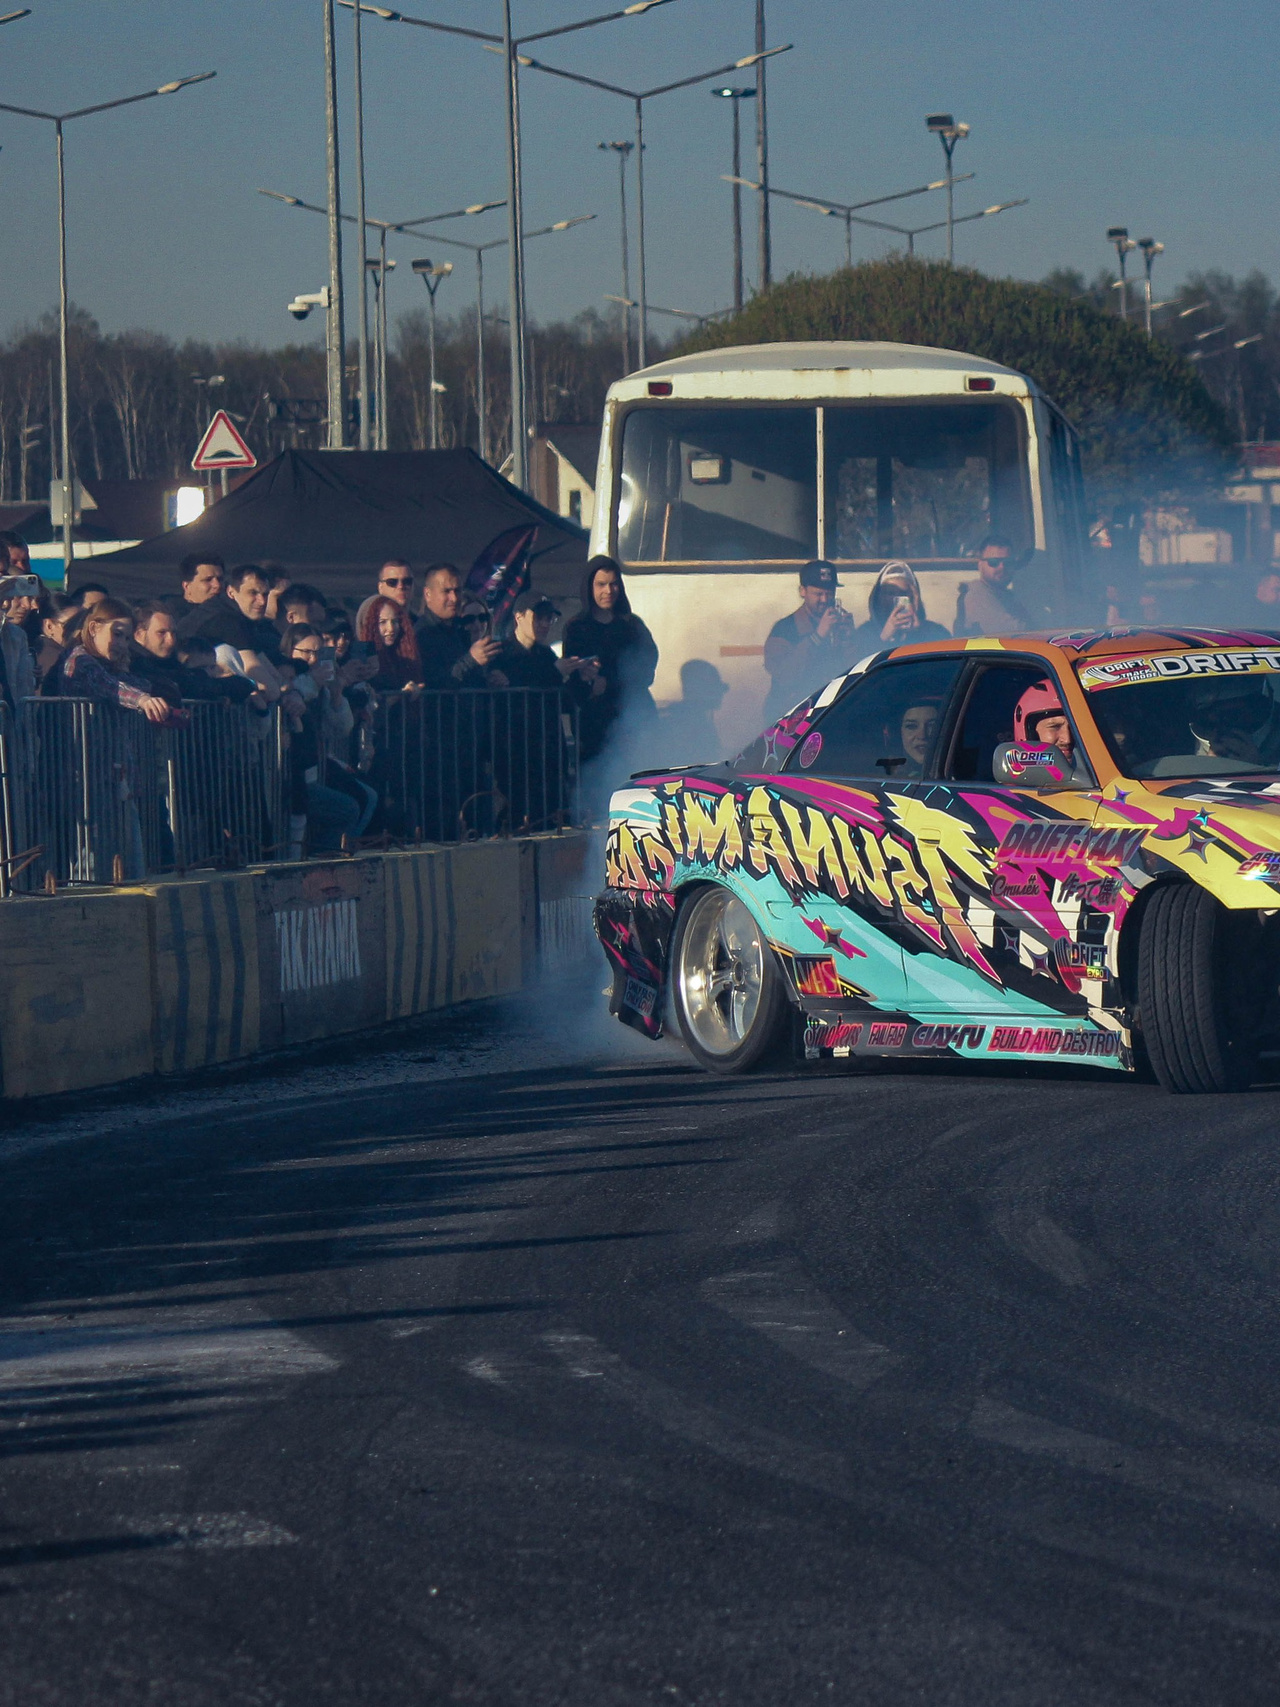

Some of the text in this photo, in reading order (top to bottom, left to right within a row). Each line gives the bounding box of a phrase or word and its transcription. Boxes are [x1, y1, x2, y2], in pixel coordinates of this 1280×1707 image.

[1105, 659, 1145, 673] DRIFT
[1121, 668, 1151, 678] TRACK
[1020, 752, 1054, 761] DRIFT
[996, 821, 1152, 863] DRIFT TAXI
[1071, 943, 1108, 966] DRIFT
[796, 961, 838, 993] VHS
[1087, 968, 1105, 978] EXPO
[989, 1027, 1122, 1055] BUILD AND DESTROY
